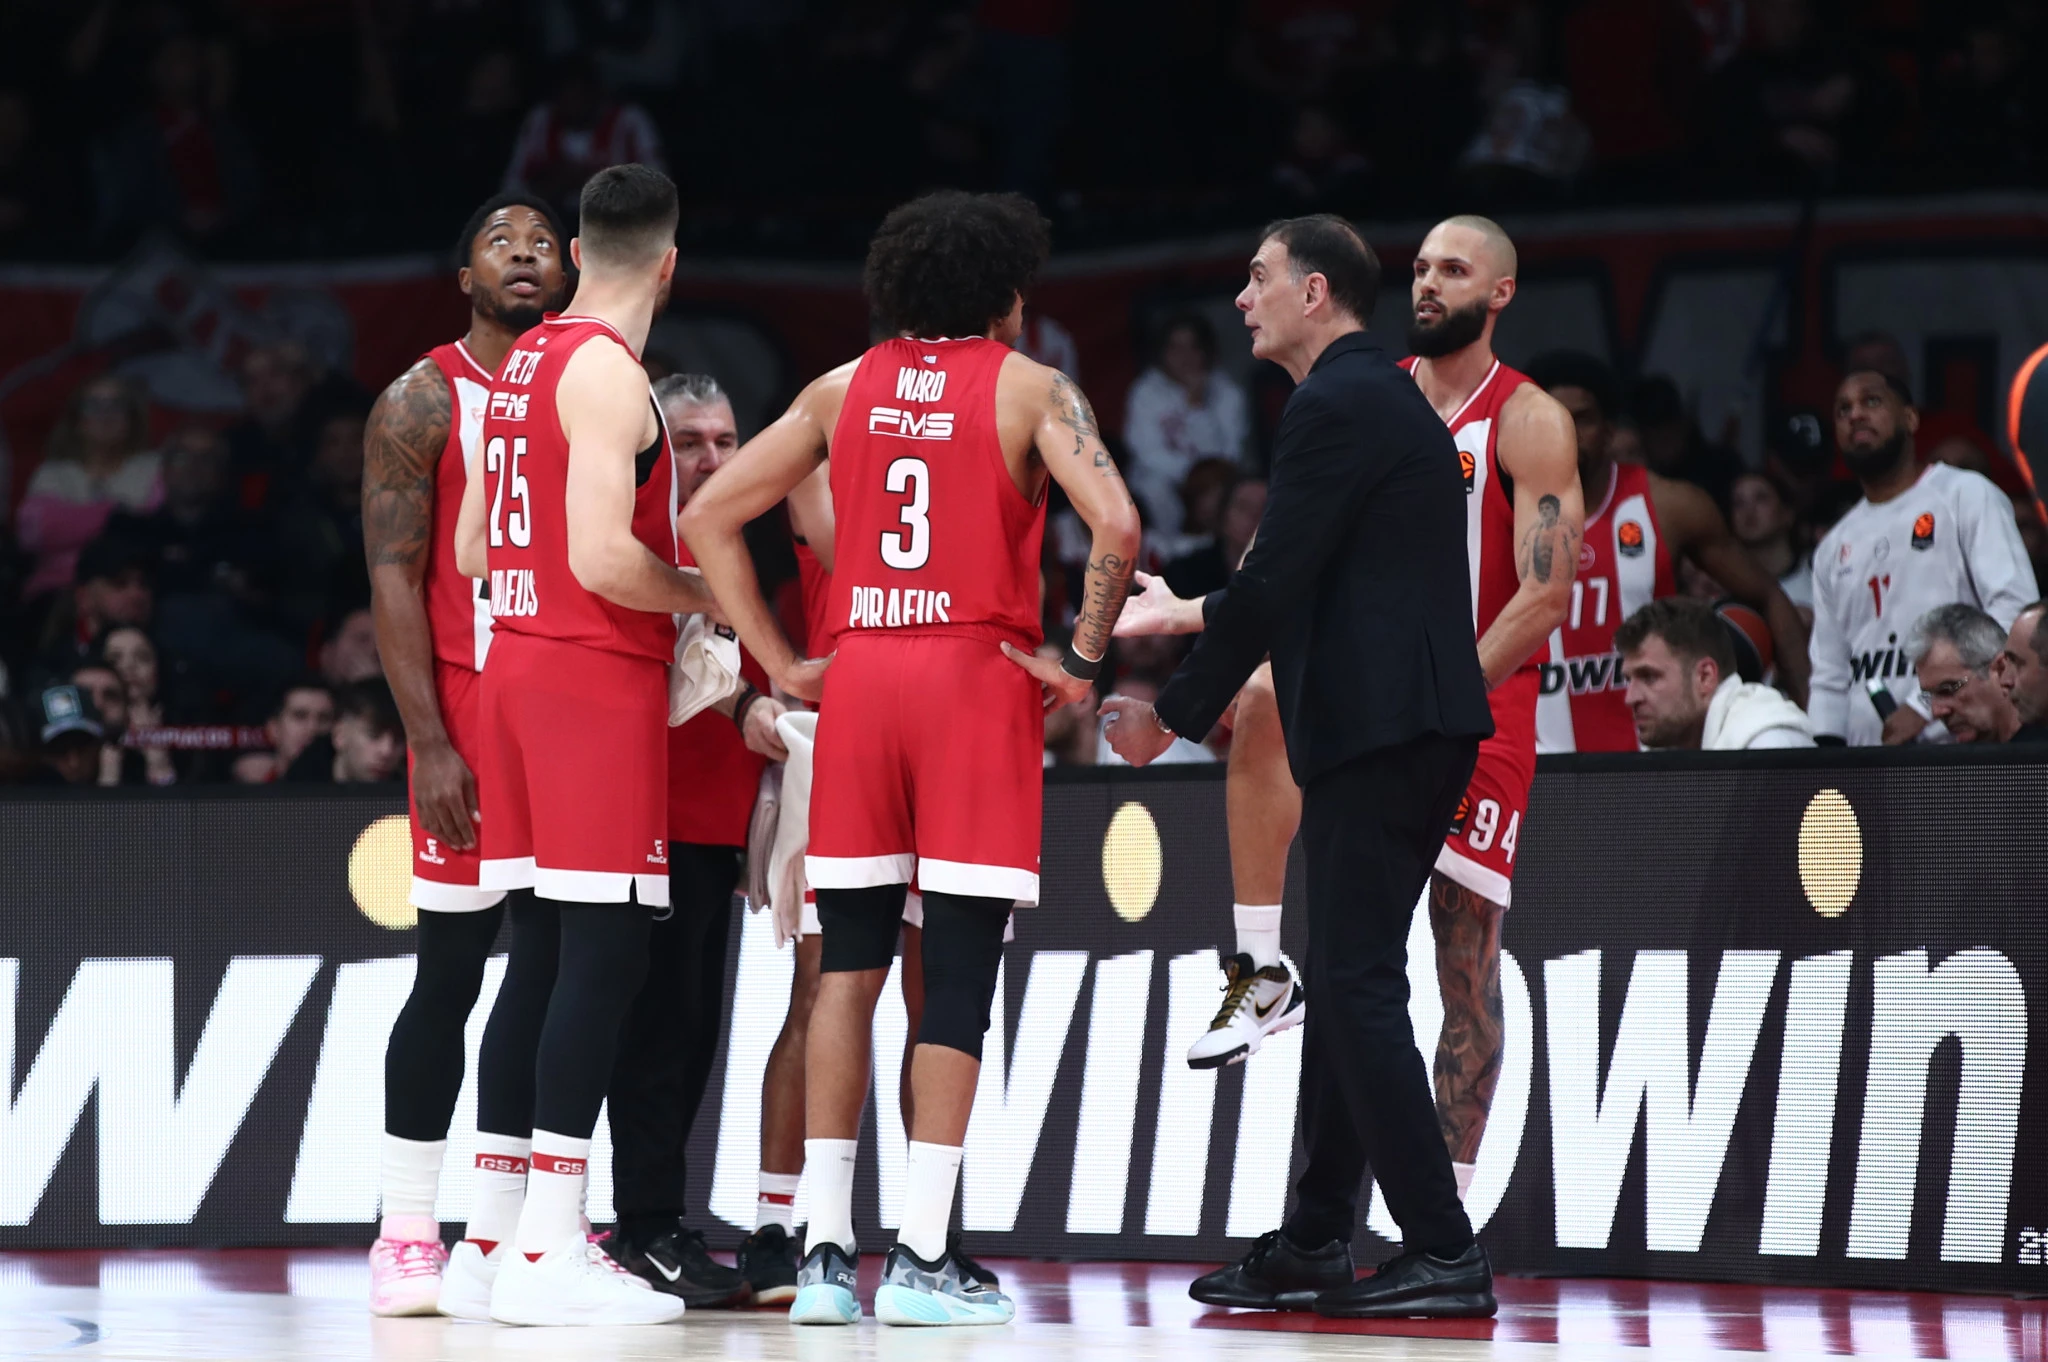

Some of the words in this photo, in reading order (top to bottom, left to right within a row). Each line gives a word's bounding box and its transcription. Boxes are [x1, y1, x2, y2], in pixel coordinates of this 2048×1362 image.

[895, 366, 947, 403] WARD
[868, 406, 955, 440] FMS
[486, 436, 531, 548] 25
[880, 456, 931, 570] 3
[1569, 576, 1609, 630] 17
[1468, 798, 1520, 865] 94
[480, 1157, 525, 1173] GSA
